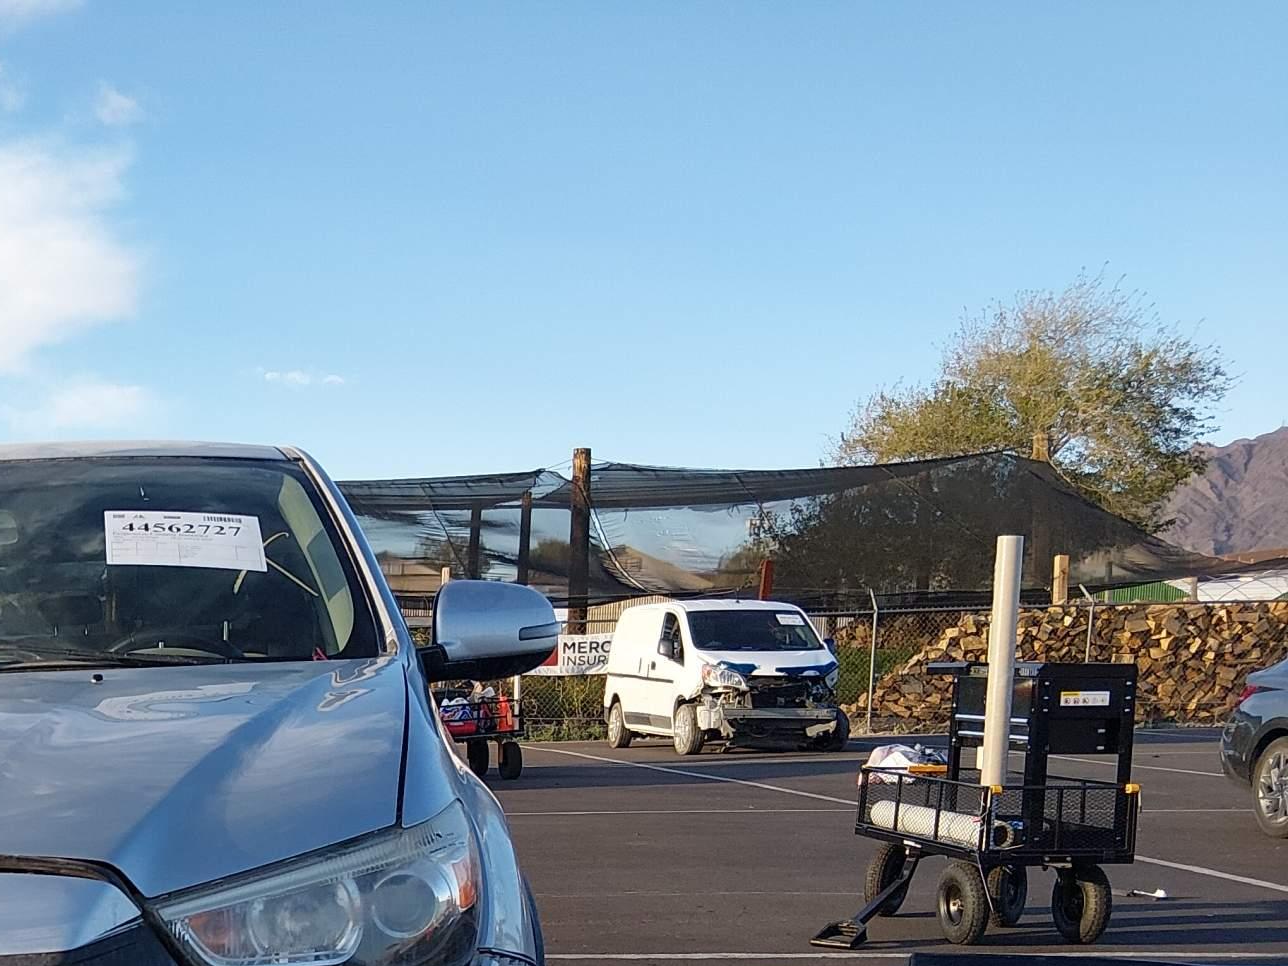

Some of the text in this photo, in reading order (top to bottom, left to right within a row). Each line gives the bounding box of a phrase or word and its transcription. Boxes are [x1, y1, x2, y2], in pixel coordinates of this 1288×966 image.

[122, 522, 241, 537] 44562727
[563, 641, 611, 654] MERC
[562, 655, 609, 666] INSUR
